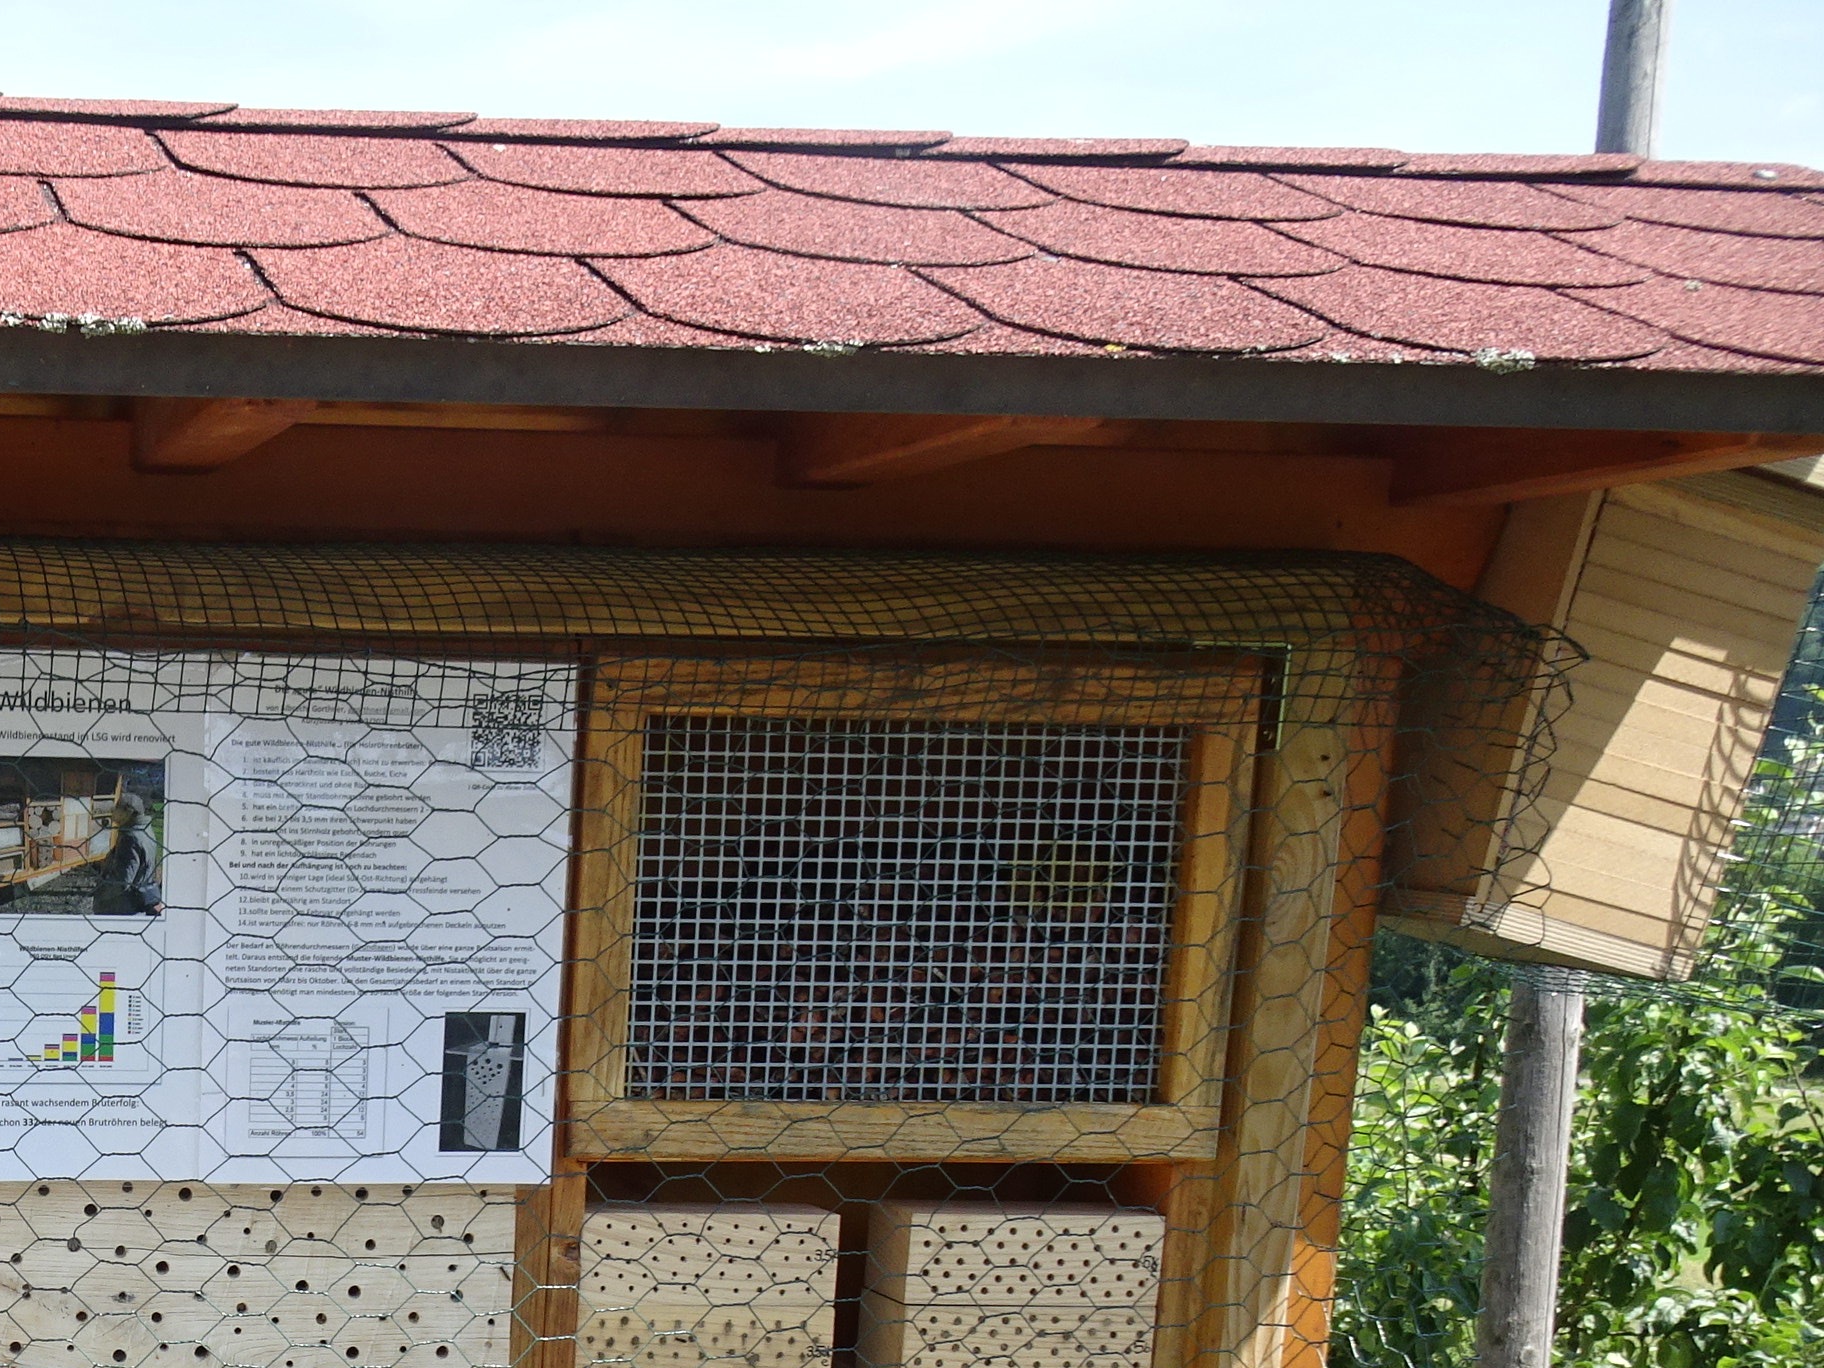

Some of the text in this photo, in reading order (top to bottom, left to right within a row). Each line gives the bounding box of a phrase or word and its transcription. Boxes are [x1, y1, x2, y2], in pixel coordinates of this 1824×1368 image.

[111, 732, 131, 742] wird
[316, 839, 344, 847] Position
[373, 863, 407, 871] beachten:
[281, 885, 303, 893] einem
[304, 885, 345, 894] Schutzgitter
[445, 921, 472, 929] Deckeln
[242, 953, 266, 961] Daraus
[248, 965, 286, 973] Standorten
[496, 978, 526, 986] Standort
[31, 1099, 89, 1107] wachsendem
[91, 1099, 140, 1109] Bruterfolg:
[88, 1118, 137, 1127] Brutröhren
